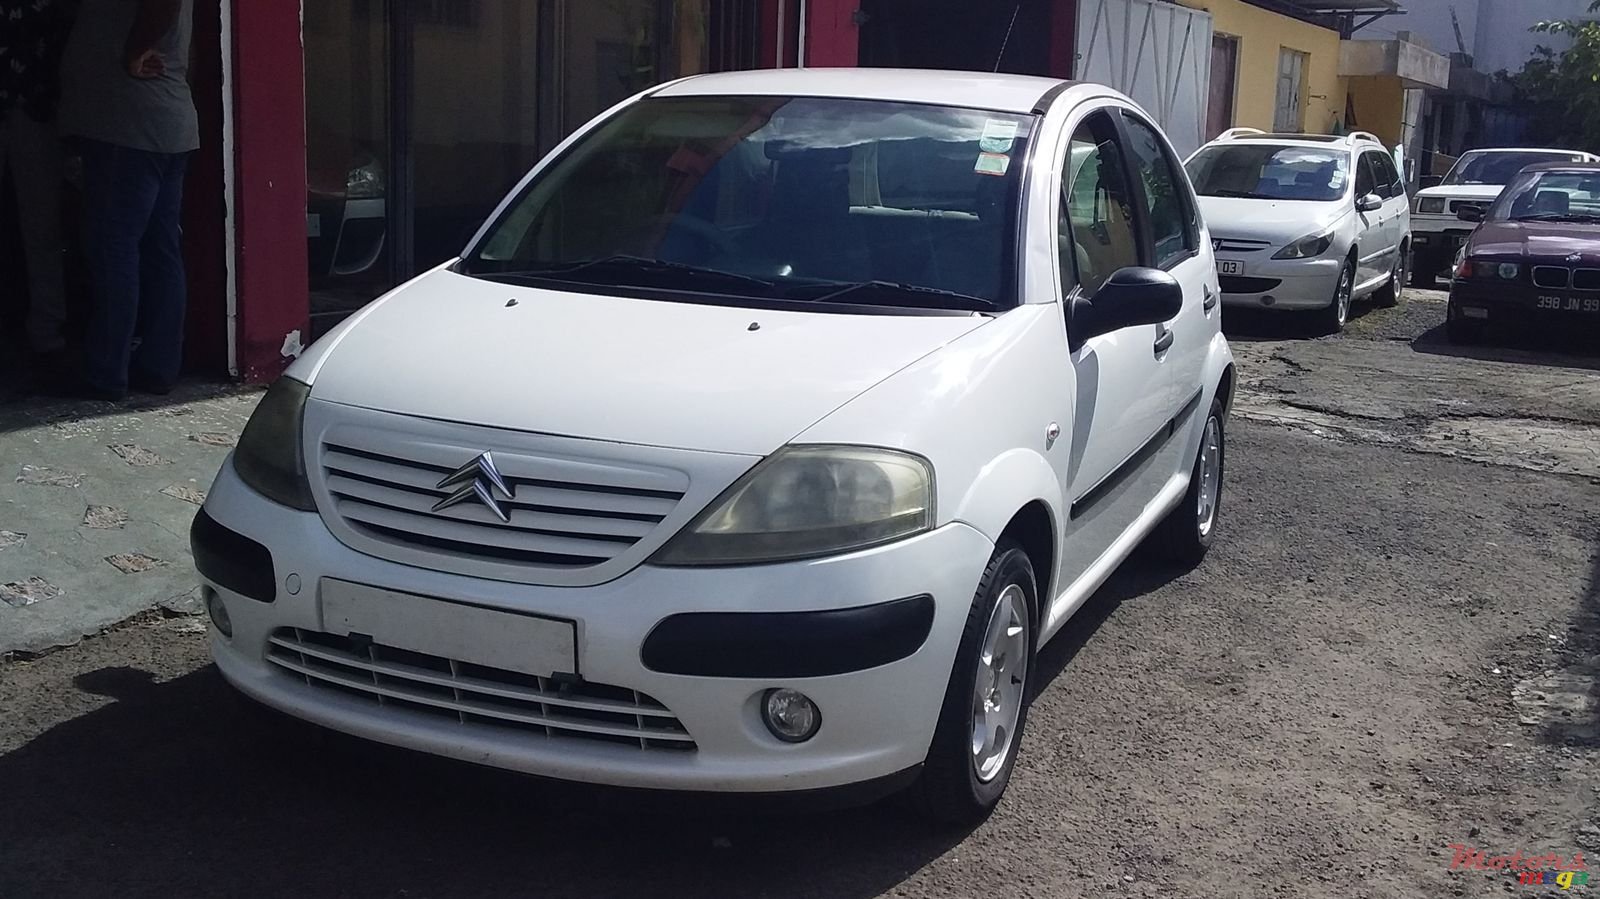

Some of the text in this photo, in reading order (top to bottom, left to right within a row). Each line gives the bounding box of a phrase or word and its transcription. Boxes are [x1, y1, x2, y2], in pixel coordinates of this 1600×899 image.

[1223, 262, 1237, 273] 03
[1537, 296, 1600, 311] 398 JN 99
